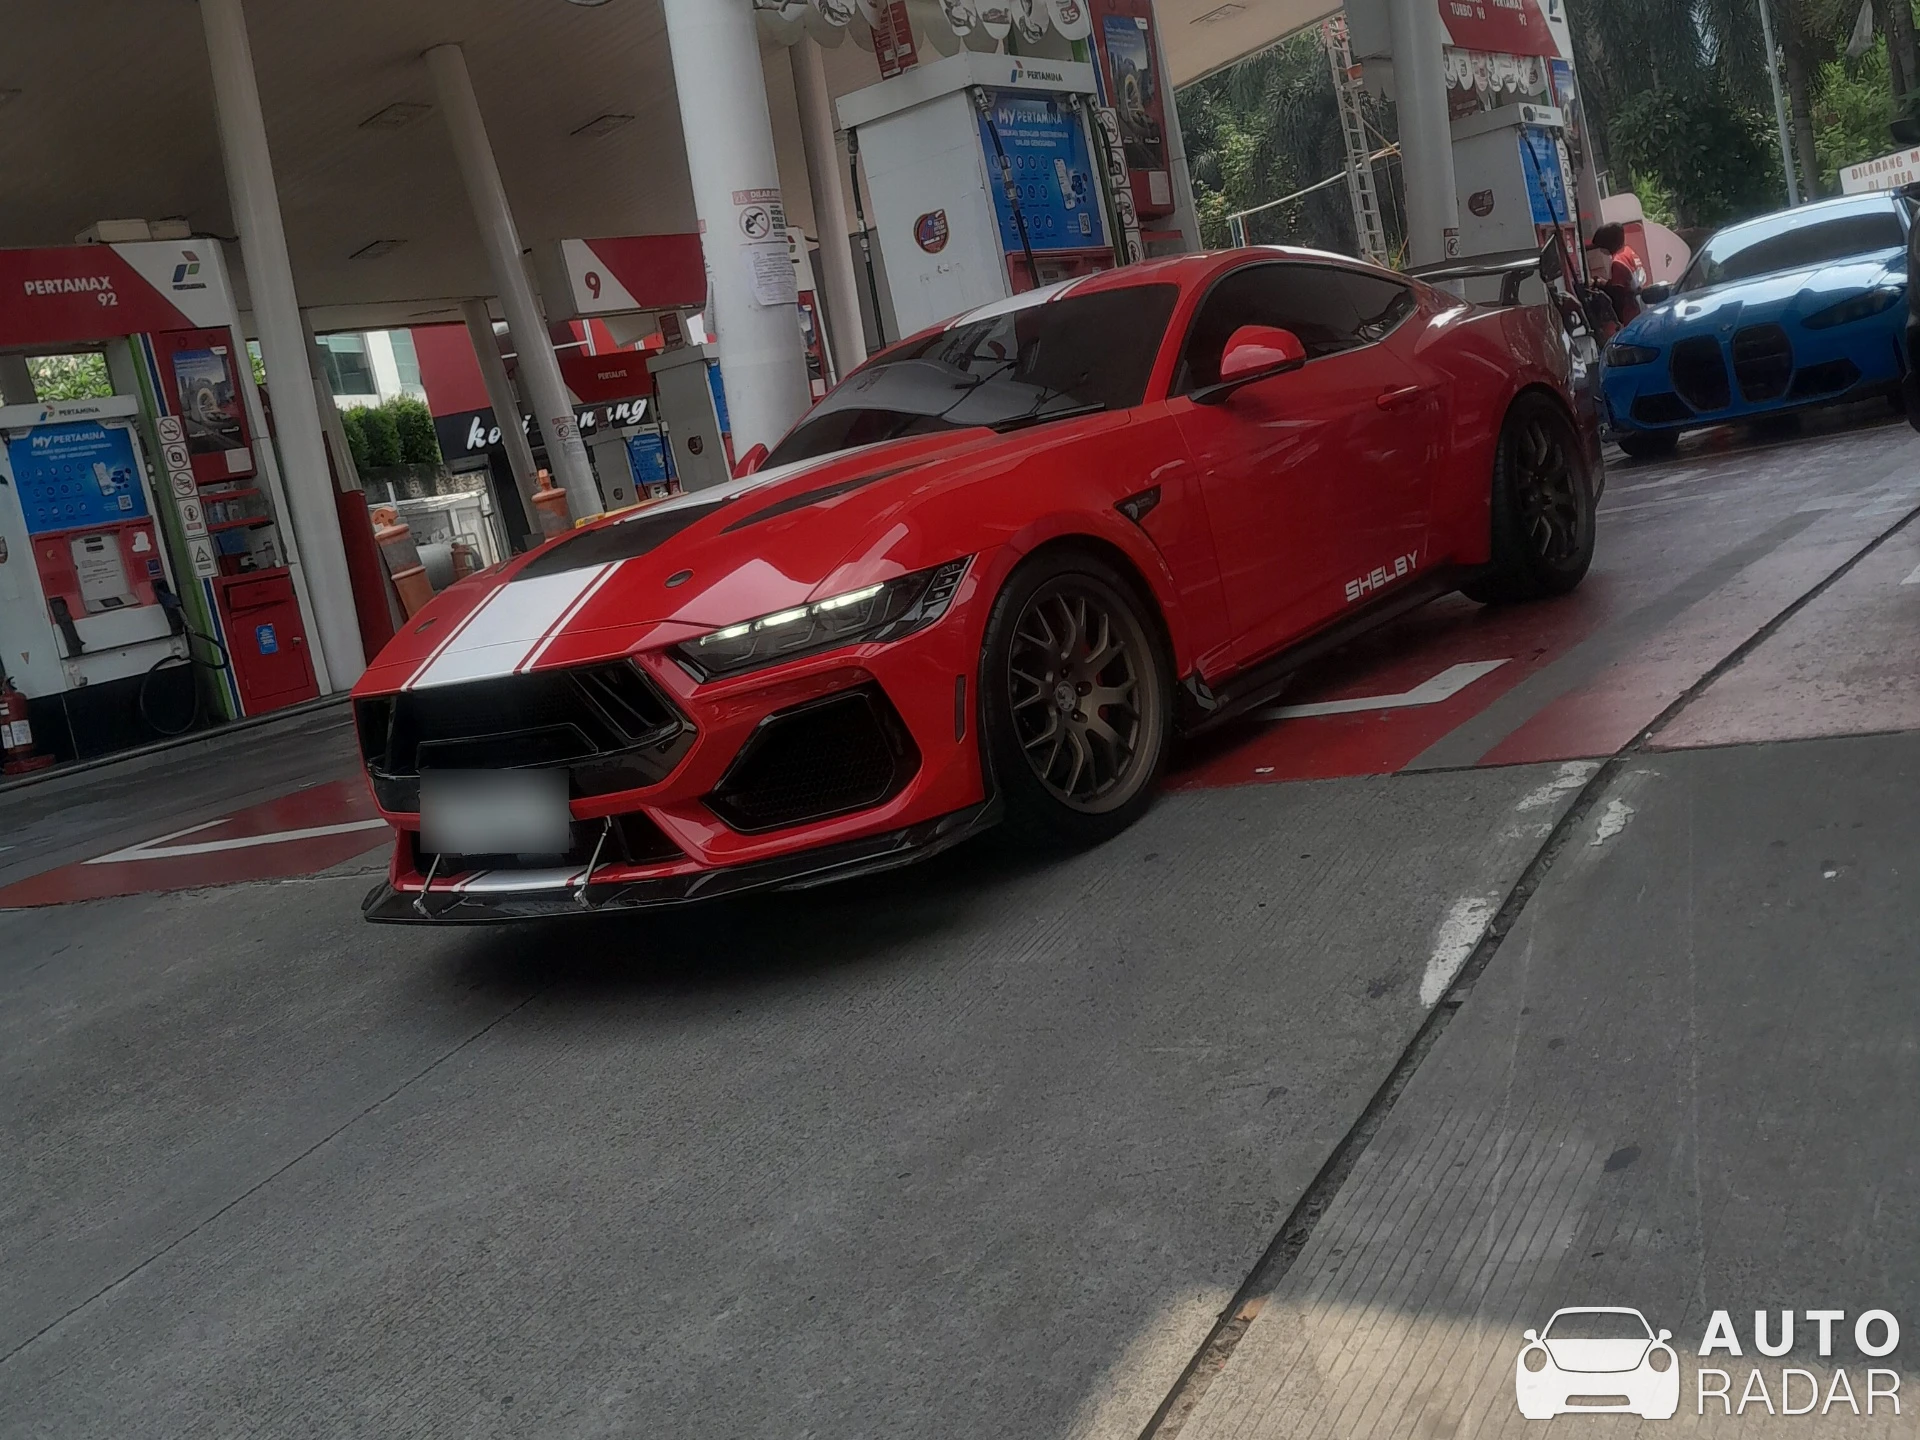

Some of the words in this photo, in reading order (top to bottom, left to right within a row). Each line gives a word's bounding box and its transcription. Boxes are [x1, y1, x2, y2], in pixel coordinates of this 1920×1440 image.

[1061, 8, 1079, 22] 35
[1518, 13, 1527, 26] 92
[1026, 70, 1063, 82] PERTAMINA
[1851, 155, 1903, 180] DILARANG
[1887, 169, 1914, 189] AREA
[24, 276, 113, 296] PERTAMAX
[584, 271, 602, 300] 9
[97, 292, 119, 307] 92
[58, 407, 101, 417] PERTAMINA
[53, 430, 105, 443] PERTAMINA
[1345, 549, 1418, 602] SHELBY
